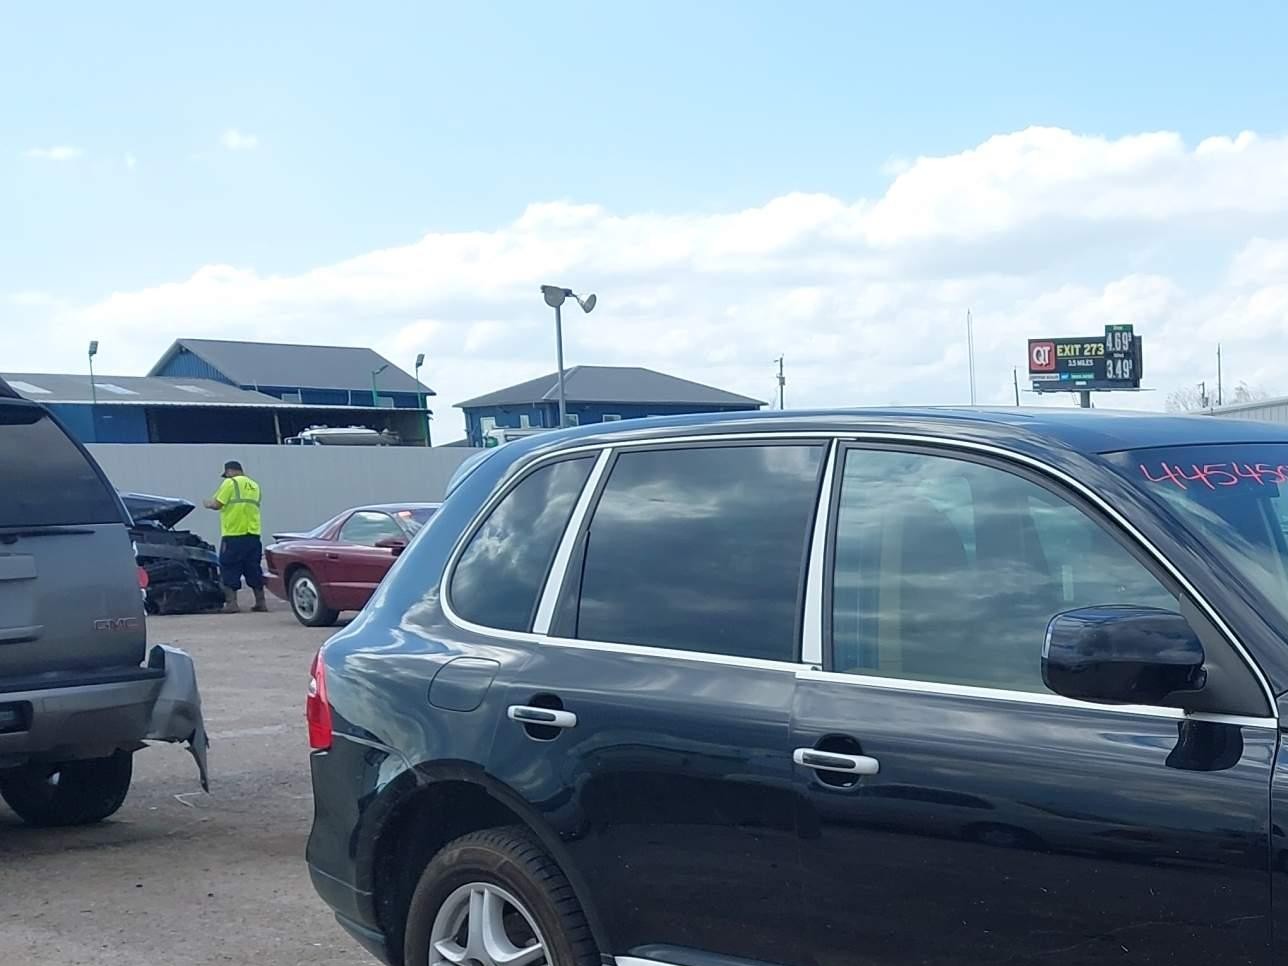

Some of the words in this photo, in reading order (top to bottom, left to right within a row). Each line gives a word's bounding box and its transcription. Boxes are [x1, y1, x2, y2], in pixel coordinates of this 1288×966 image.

[1032, 346, 1051, 366] QT
[1056, 344, 1081, 357] EXIT
[1083, 343, 1104, 356] 273
[1077, 359, 1094, 367] MILES
[93, 616, 138, 631] GMC
